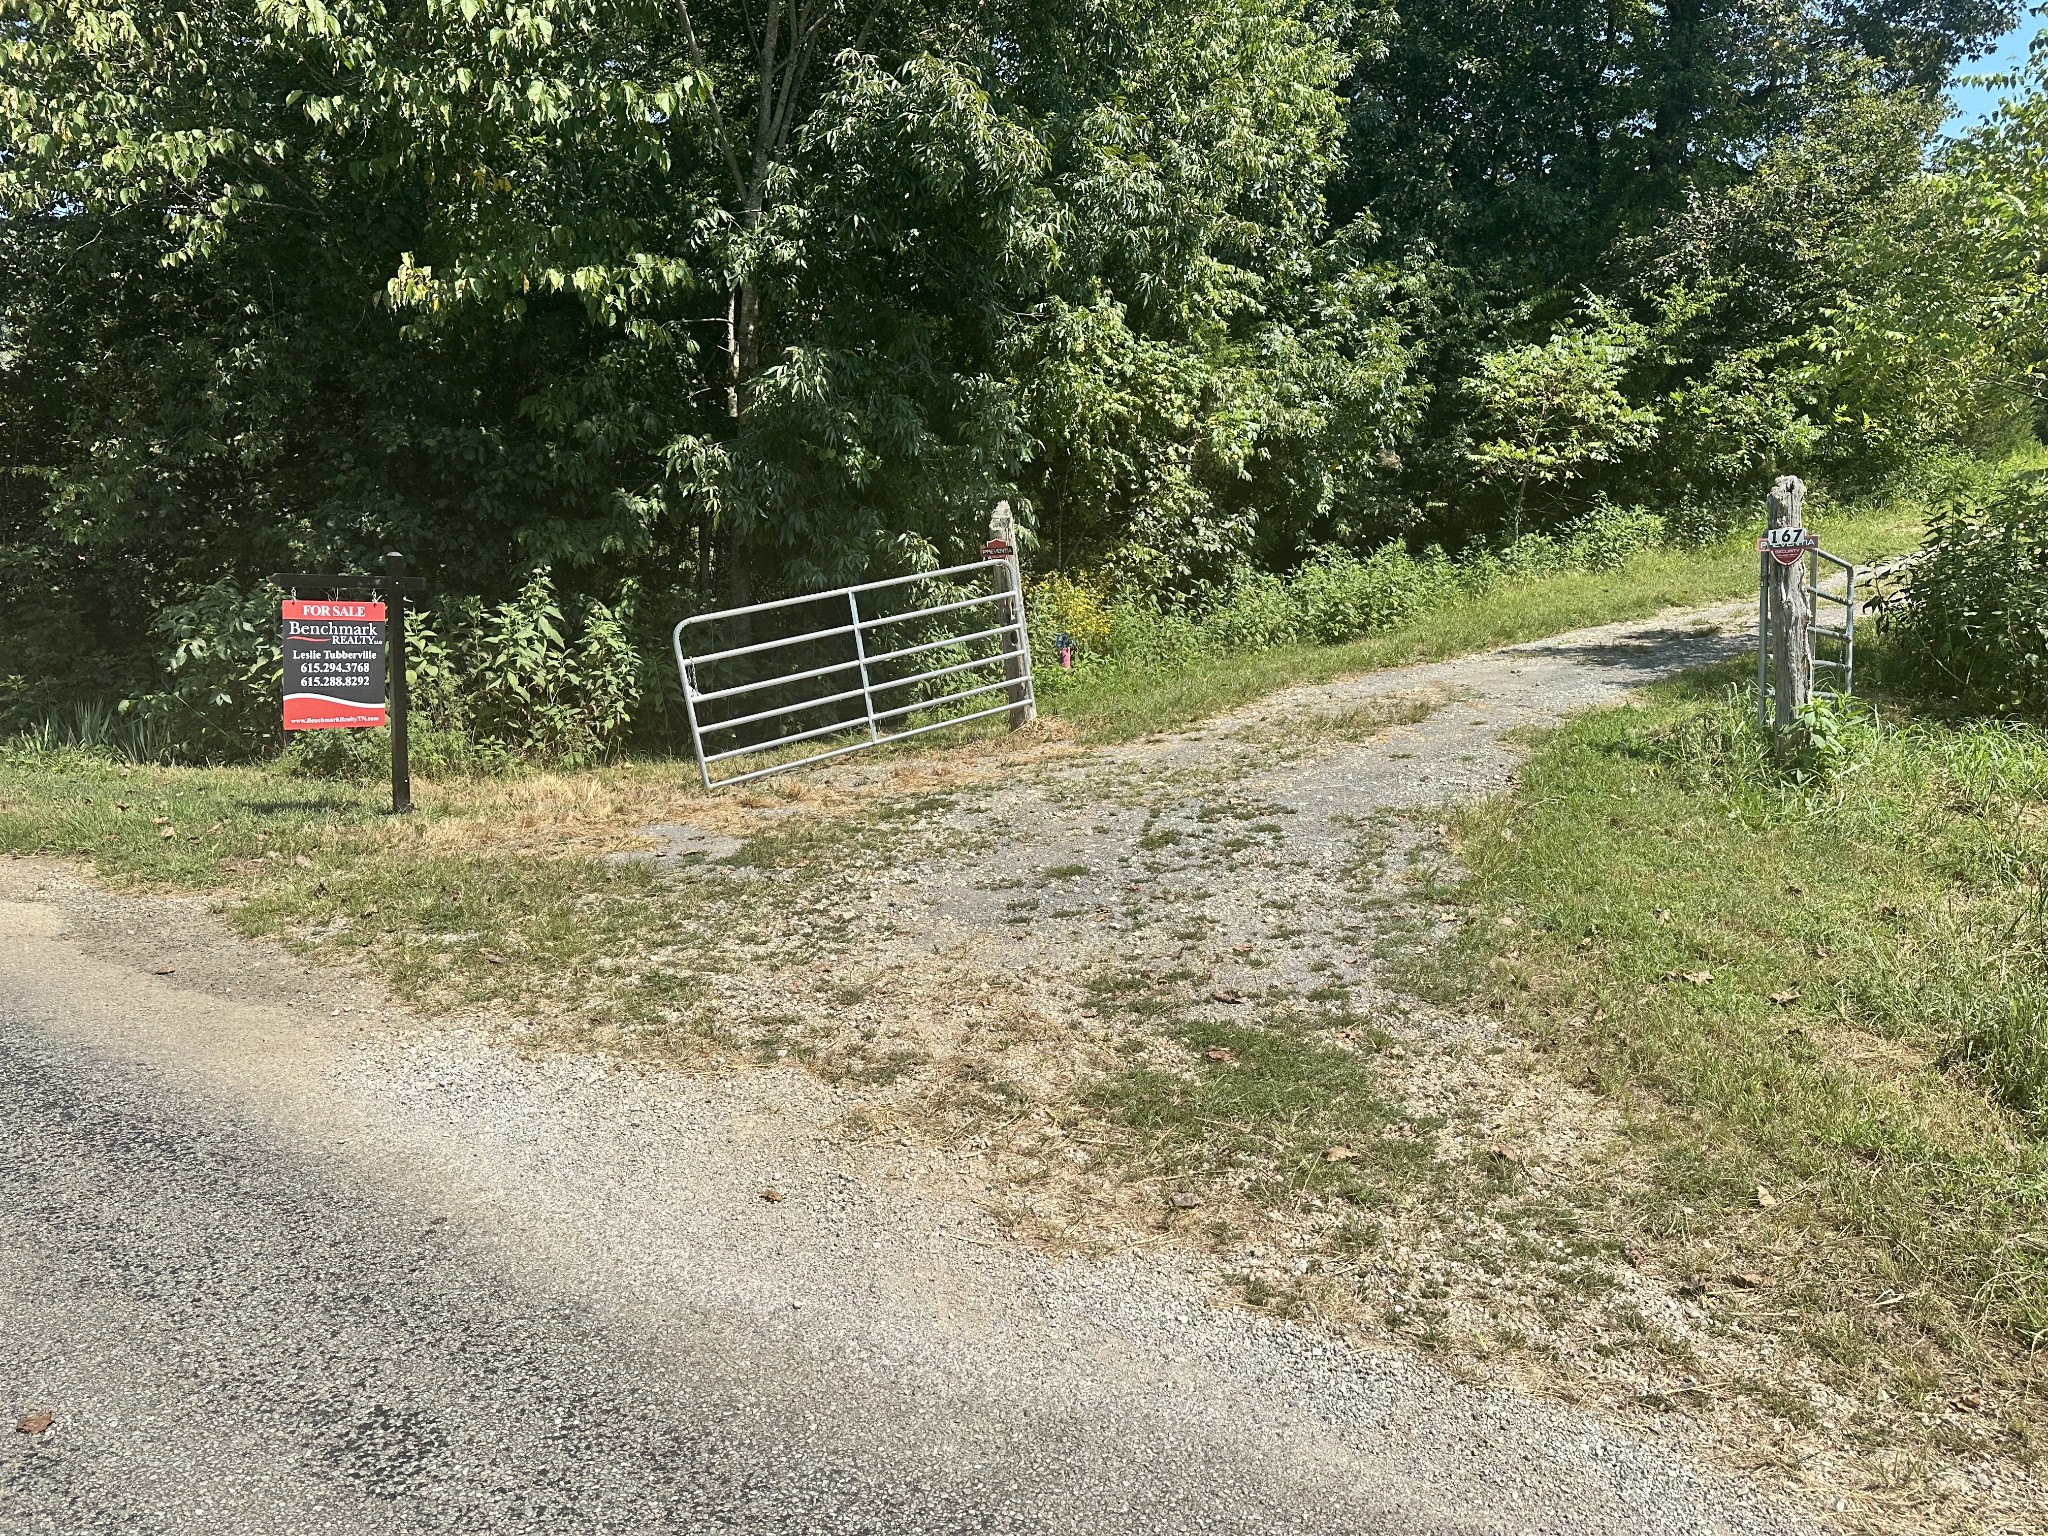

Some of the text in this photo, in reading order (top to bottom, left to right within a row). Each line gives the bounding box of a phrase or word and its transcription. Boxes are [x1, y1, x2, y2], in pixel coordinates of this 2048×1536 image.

[1772, 530, 1802, 544] 167
[303, 605, 366, 617] FOR SALE
[289, 621, 378, 636] Benchmark
[332, 636, 374, 644] REALTY
[293, 650, 377, 660] Leslie Tubberville
[300, 663, 370, 673] 615.294.3768
[300, 676, 370, 687] 615.288.8292
